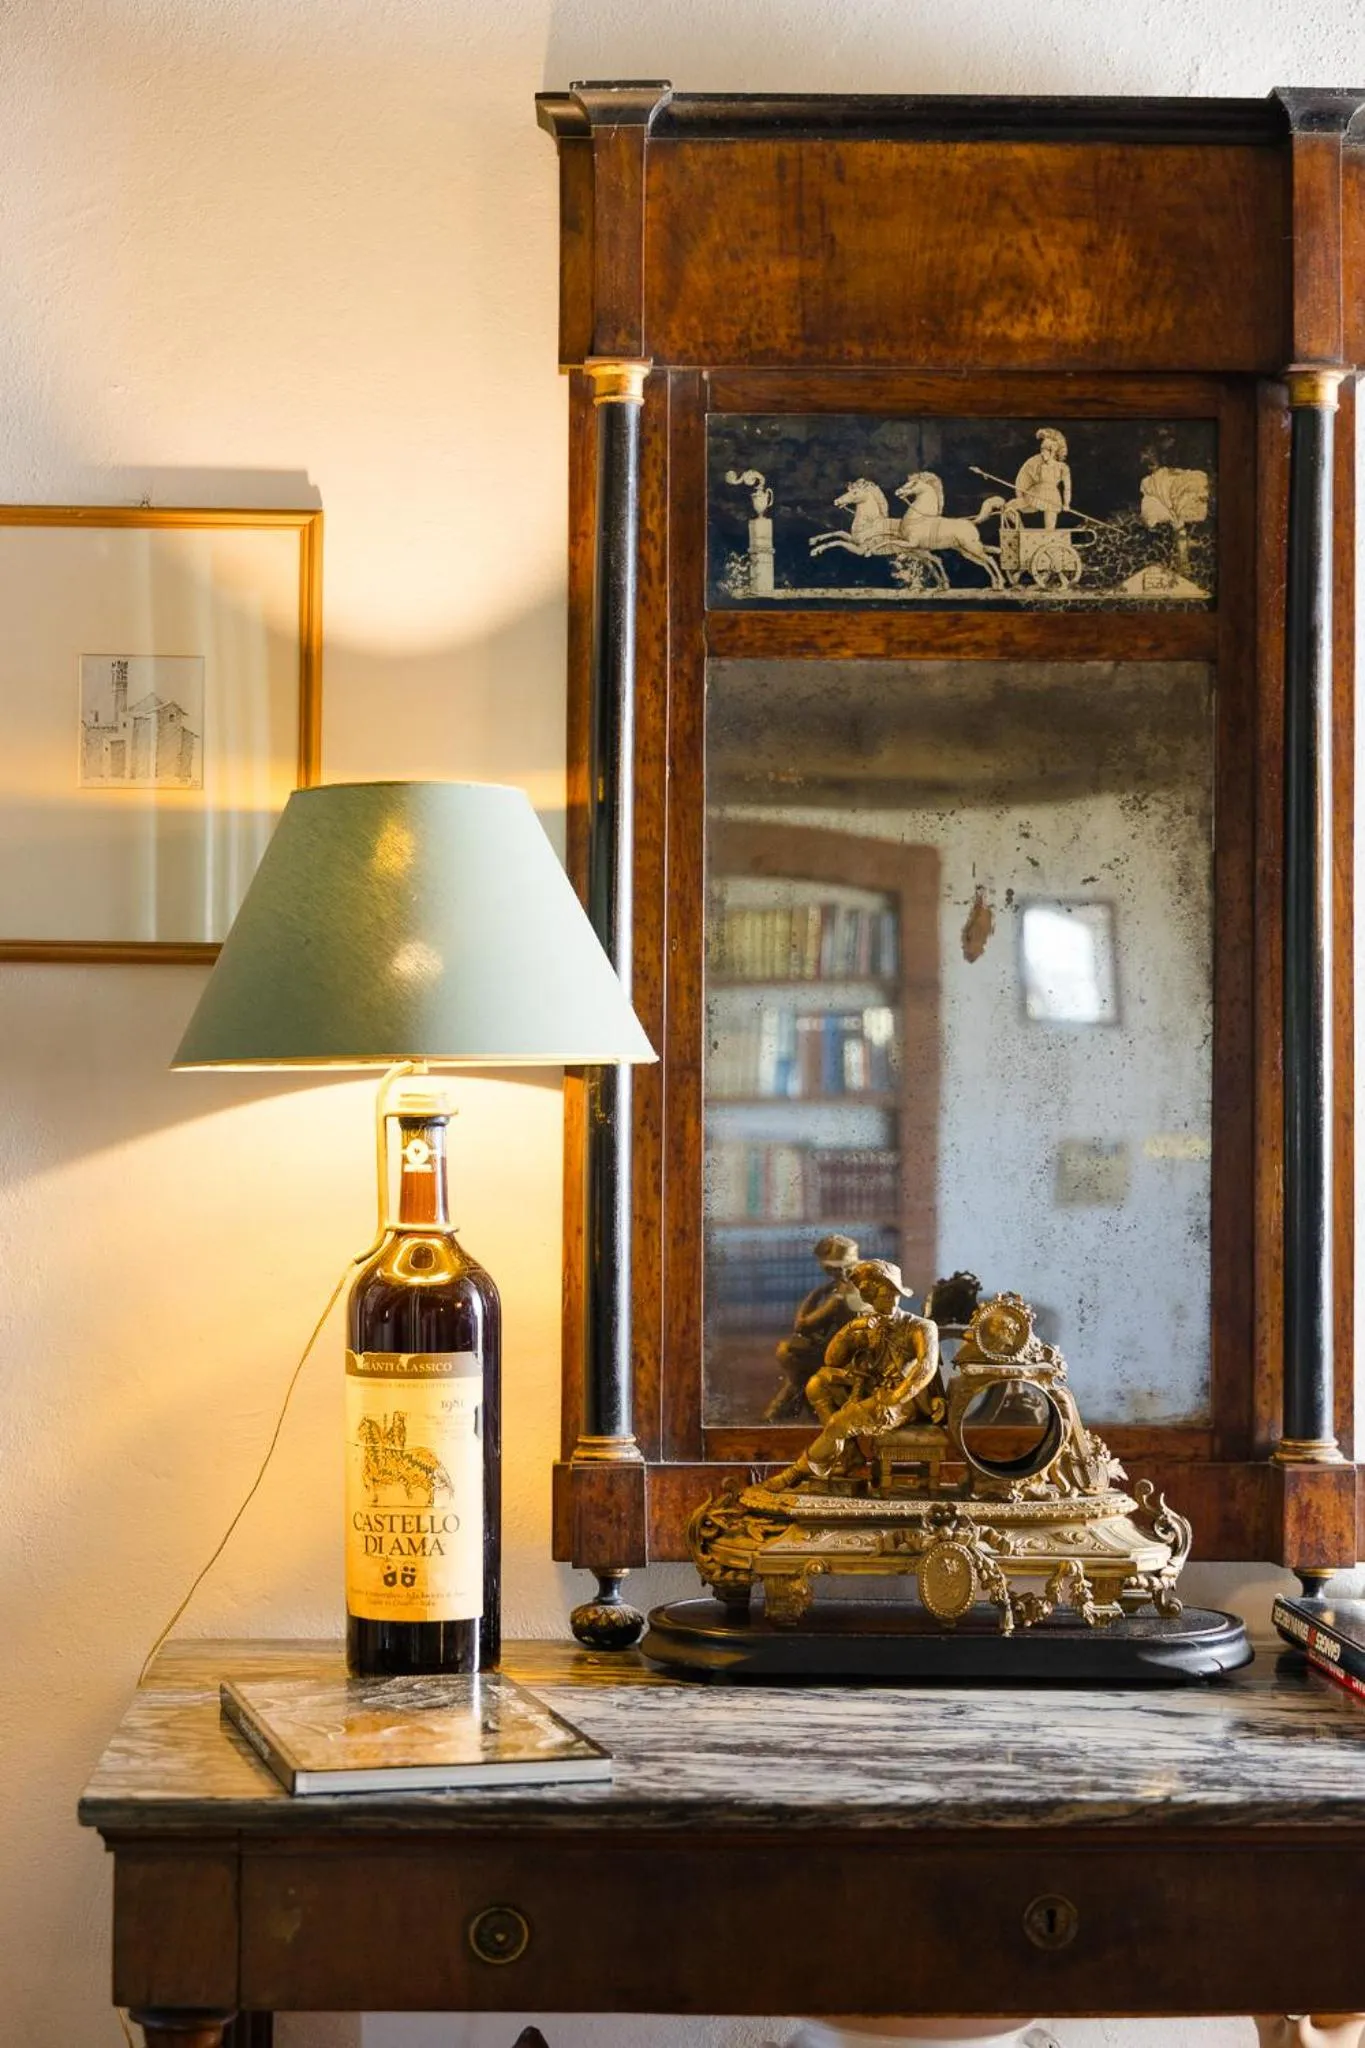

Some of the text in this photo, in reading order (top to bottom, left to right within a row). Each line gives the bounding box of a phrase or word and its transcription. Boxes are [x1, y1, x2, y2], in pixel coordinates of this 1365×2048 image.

[396, 1362, 453, 1373] CLASSICO
[352, 1511, 460, 1534] CASTELLO
[364, 1535, 447, 1556] DI AMA
